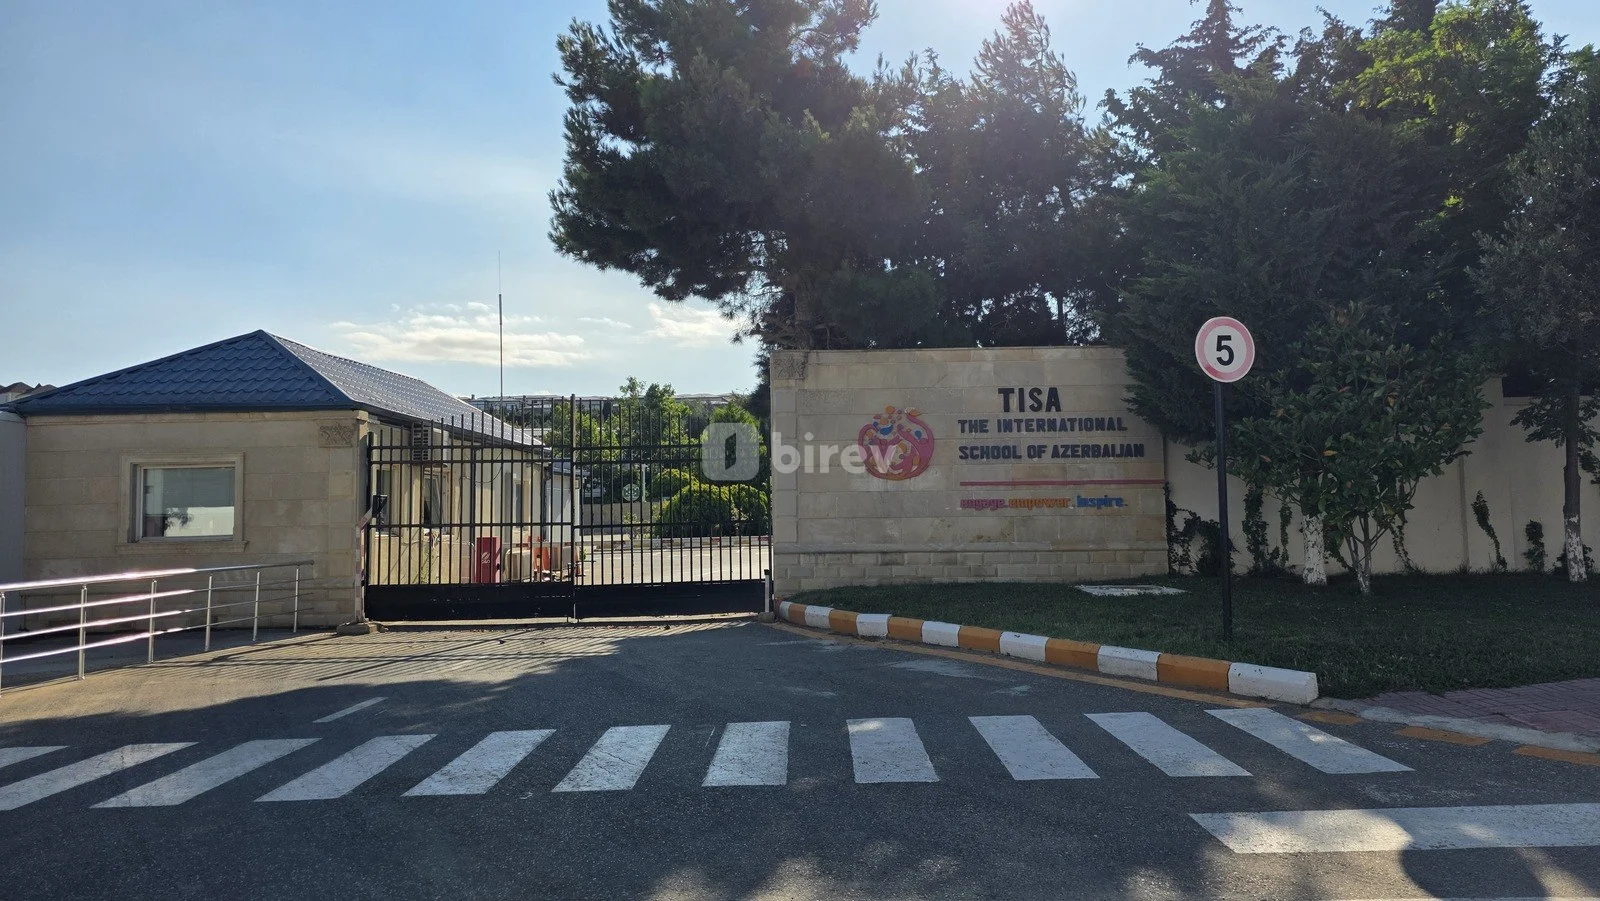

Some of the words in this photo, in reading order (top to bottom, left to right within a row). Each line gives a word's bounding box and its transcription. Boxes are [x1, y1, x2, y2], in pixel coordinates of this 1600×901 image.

[1216, 335, 1234, 366] 5
[998, 387, 1062, 412] TISA
[958, 419, 989, 434] THE
[997, 417, 1128, 433] INTERNATIONAL
[958, 445, 1022, 460] SCHOOL
[1027, 444, 1048, 459] OF
[1051, 443, 1145, 459] AZERBAIJAN
